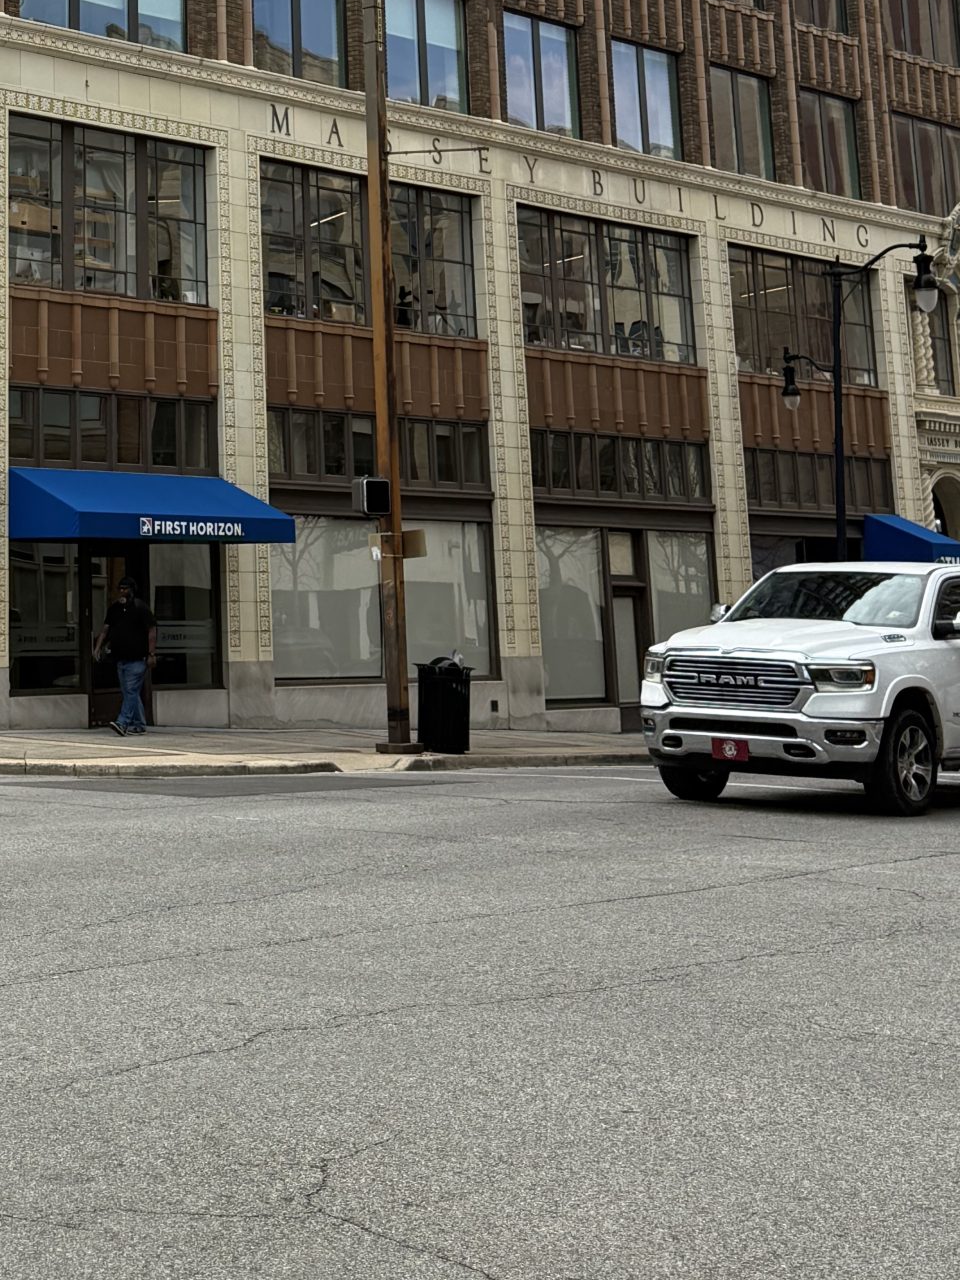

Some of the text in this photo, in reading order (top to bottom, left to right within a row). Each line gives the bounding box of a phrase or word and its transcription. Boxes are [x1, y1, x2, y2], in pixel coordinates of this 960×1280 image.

[591, 170, 869, 248] BUILDING
[154, 520, 187, 535] FIRST
[699, 673, 755, 685] RAM
